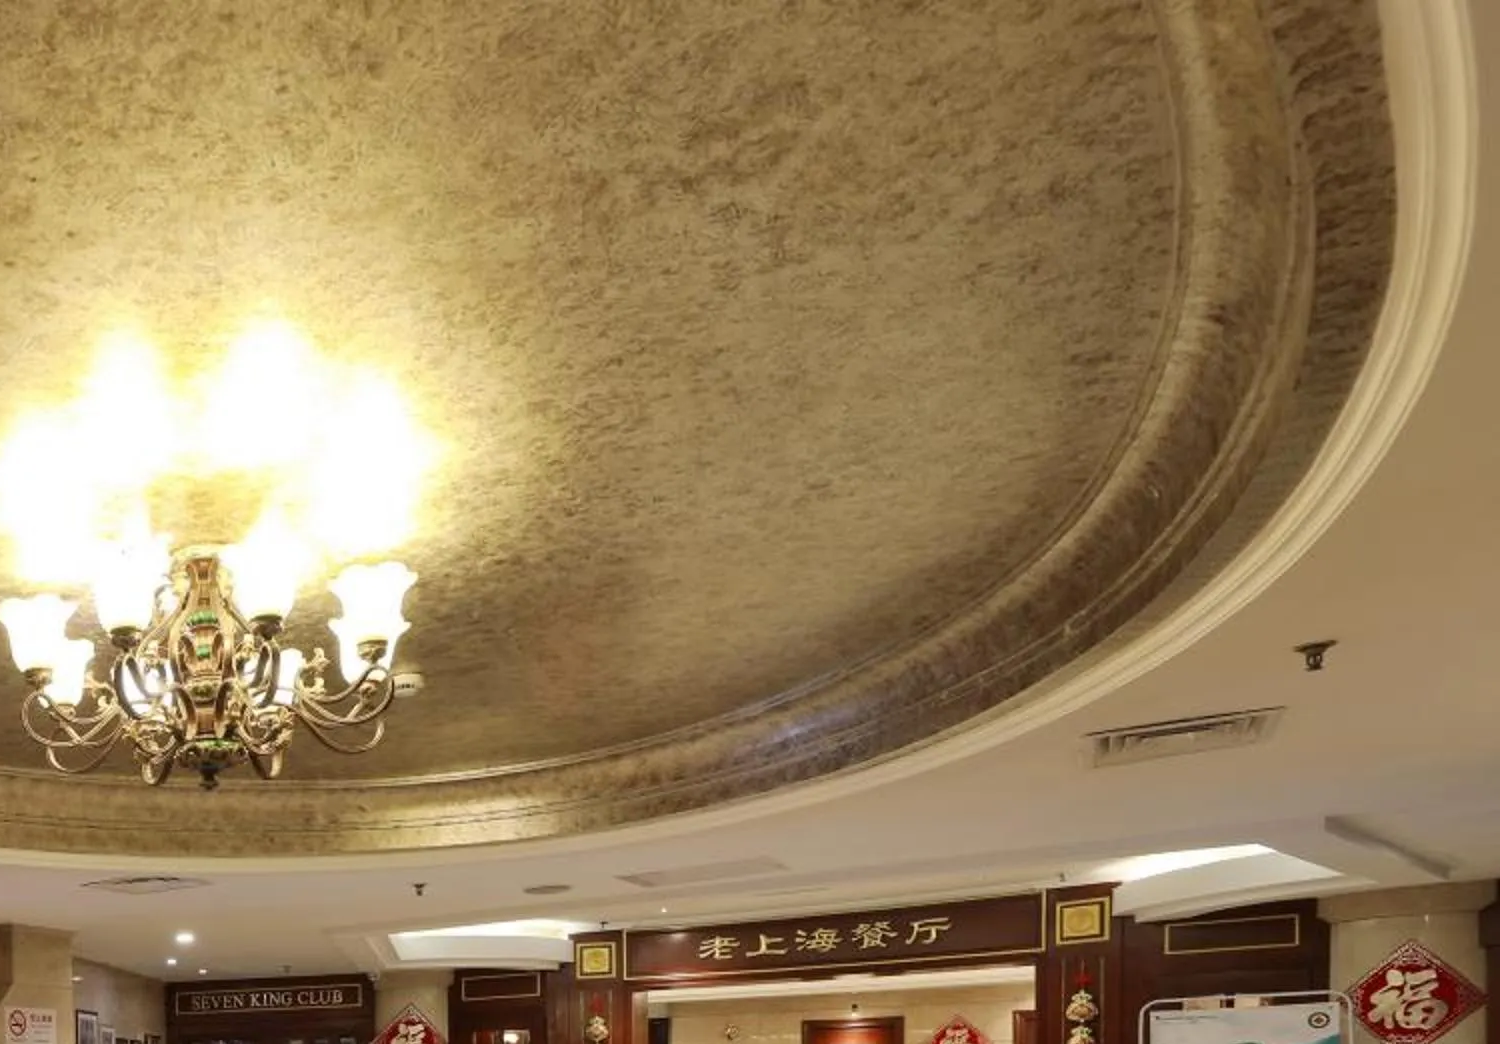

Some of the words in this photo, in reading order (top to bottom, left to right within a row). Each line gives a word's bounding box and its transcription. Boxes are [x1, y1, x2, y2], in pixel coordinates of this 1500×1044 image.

[697, 916, 953, 960] 老上海餐厅
[191, 991, 247, 1010] SEVEN
[250, 989, 293, 1007] KING
[297, 988, 344, 1005] CLUB
[1367, 969, 1449, 1030] 福
